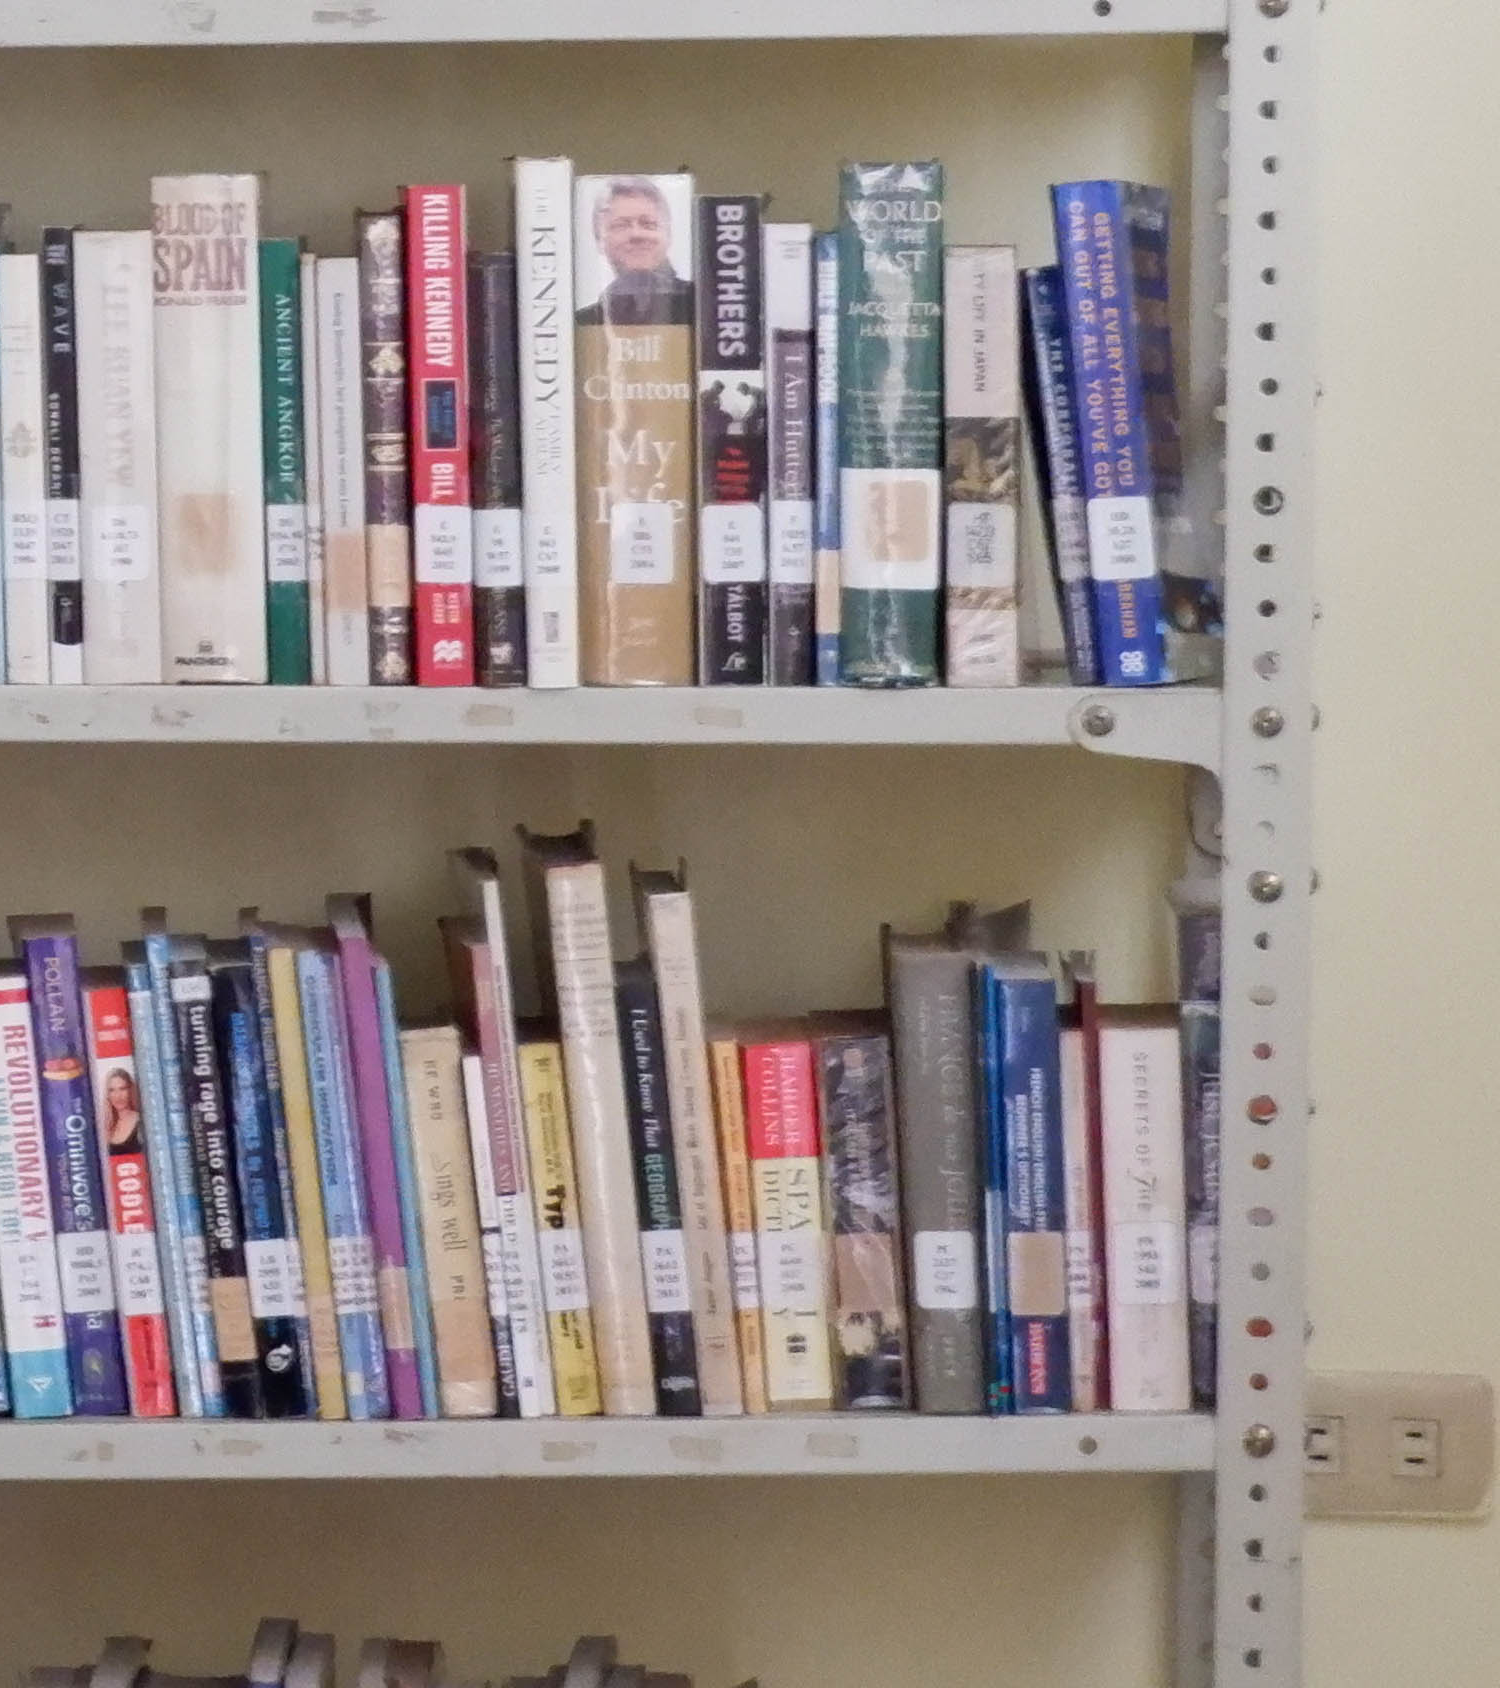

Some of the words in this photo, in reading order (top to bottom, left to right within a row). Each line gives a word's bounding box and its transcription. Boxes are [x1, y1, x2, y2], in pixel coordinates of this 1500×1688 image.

[420, 192, 450, 271] KILLING
[846, 198, 944, 224] WORLD
[1067, 199, 1091, 244] CAN
[153, 240, 247, 292] SPAIN
[714, 203, 748, 359] BROTHERS
[1070, 250, 1096, 296] OUT
[1092, 210, 1119, 299] GETTING
[274, 292, 295, 387] ANCIENT
[422, 275, 454, 368] KENNEDY
[529, 223, 562, 413] KENNEDY
[1077, 300, 1100, 330] OF
[616, 335, 662, 362] Bill
[1080, 332, 1104, 376] ALL
[1101, 306, 1130, 438] EVERYTHING
[583, 376, 690, 402] Clinton
[276, 393, 297, 484] ANGKOR
[606, 429, 677, 474] My
[1113, 444, 1137, 488] YOU
[429, 461, 457, 500] BILL
[726, 584, 746, 644] TALBOT
[42, 955, 68, 1033] POLLAN
[188, 1004, 212, 1076] turning
[3, 1023, 48, 1221] REVOLUTIONARY
[196, 1080, 219, 1124] rage
[206, 1128, 227, 1171] into
[208, 1174, 236, 1251] courage
